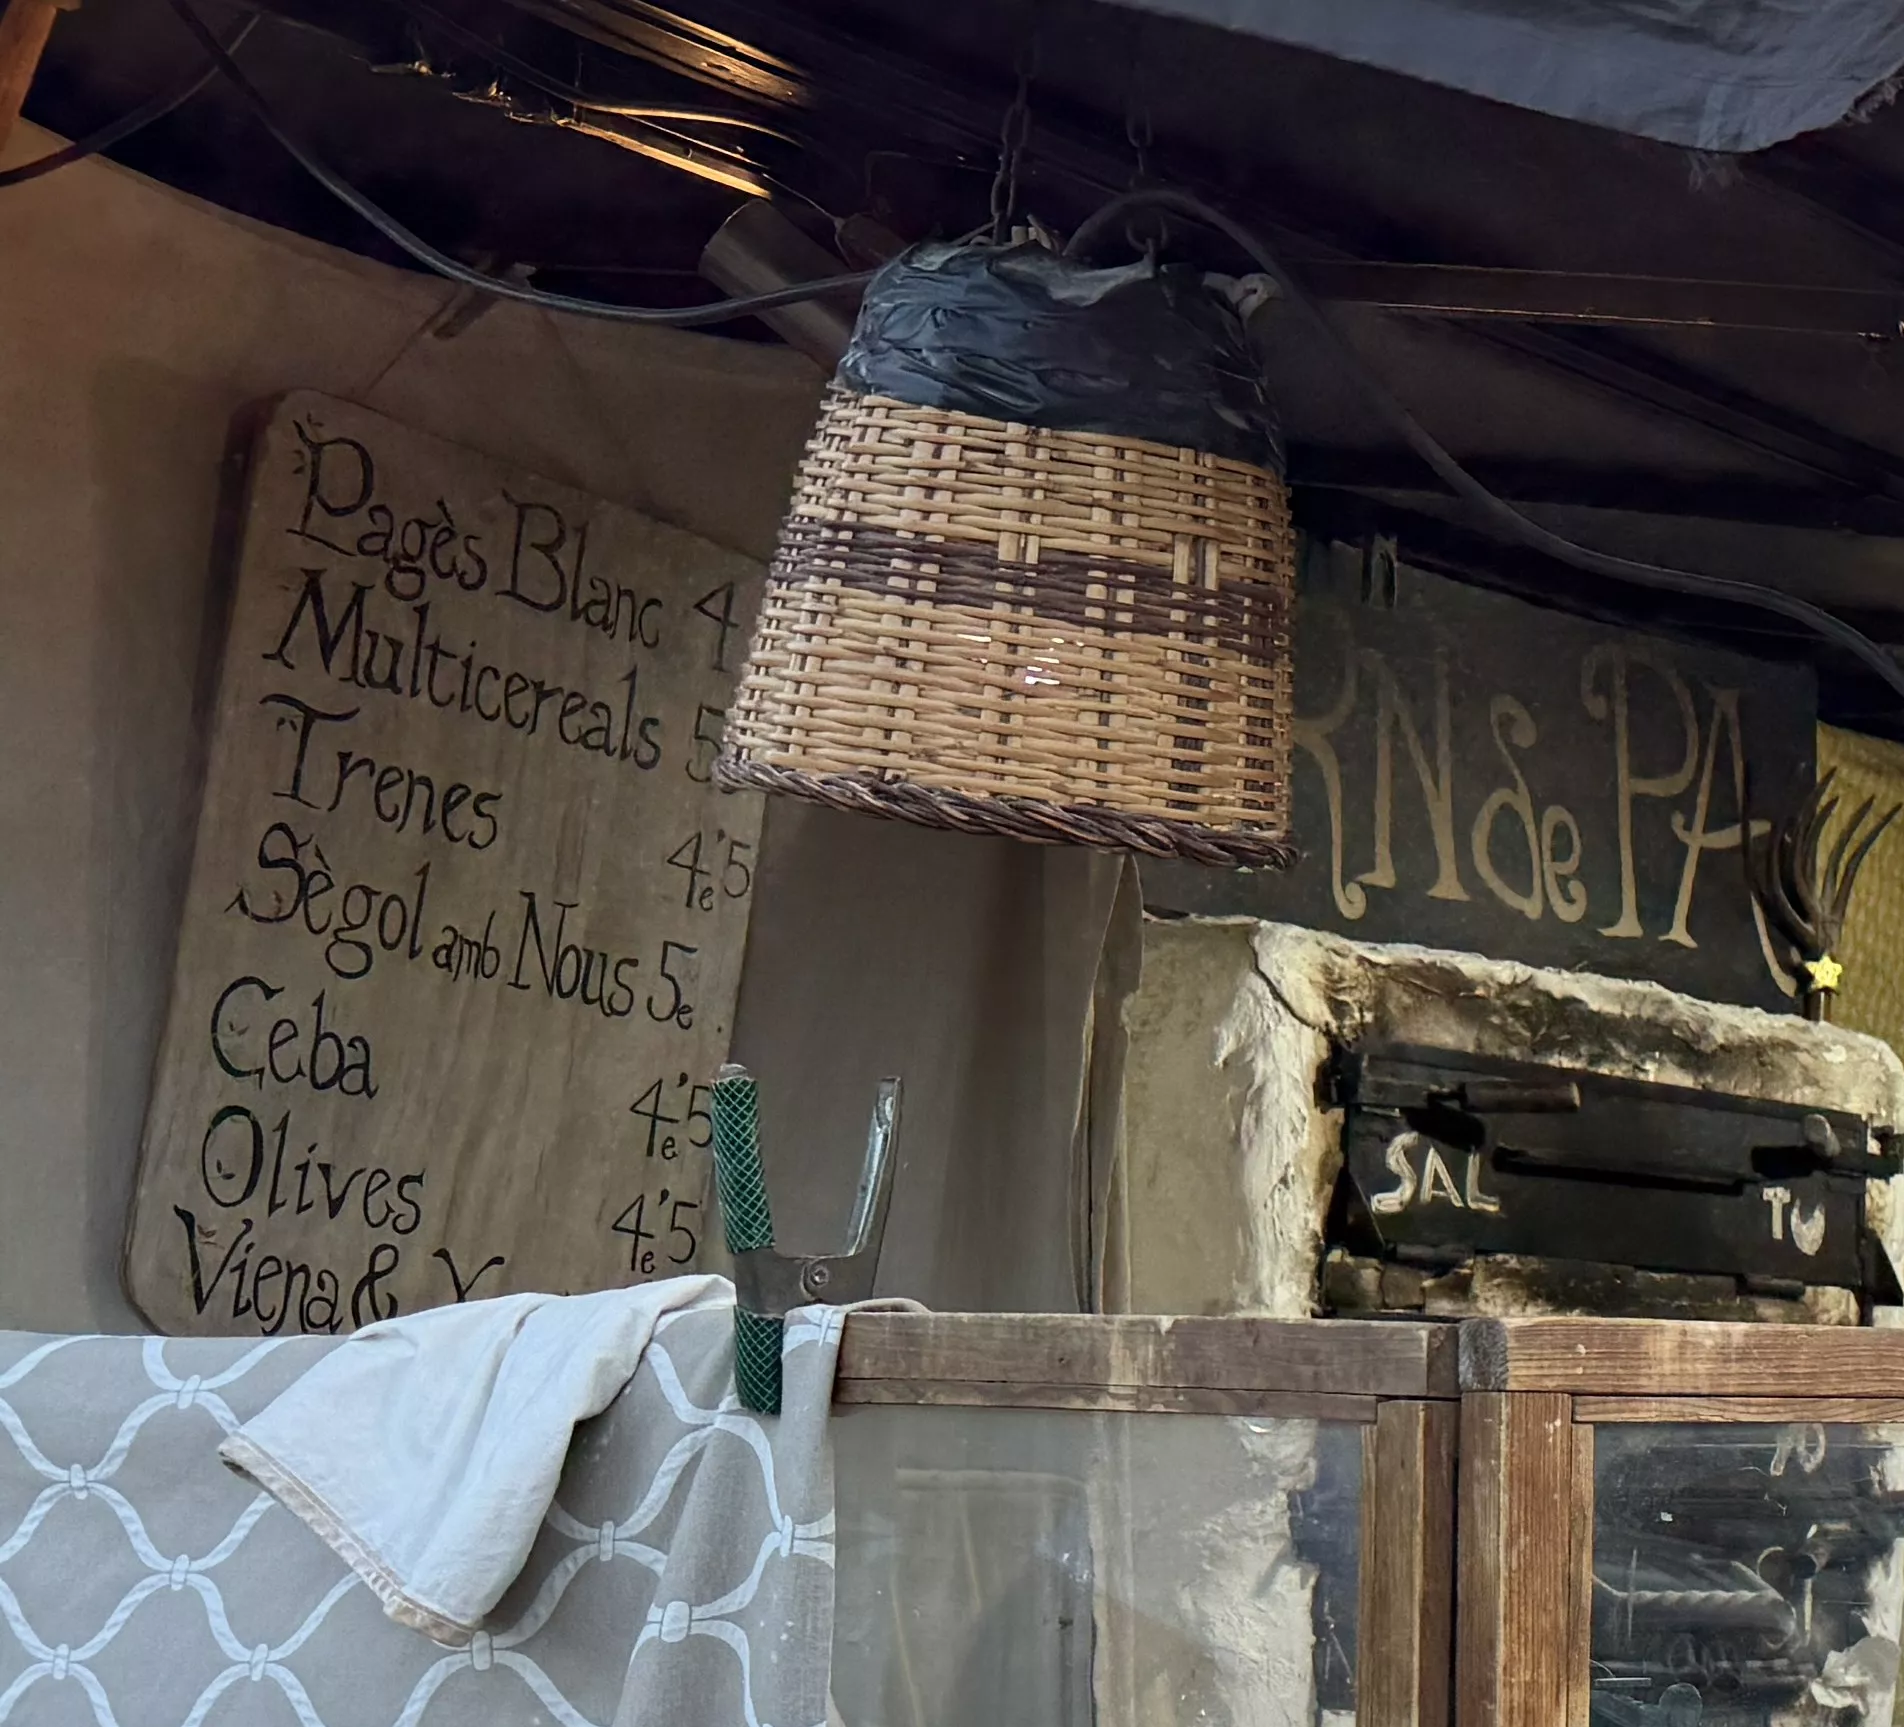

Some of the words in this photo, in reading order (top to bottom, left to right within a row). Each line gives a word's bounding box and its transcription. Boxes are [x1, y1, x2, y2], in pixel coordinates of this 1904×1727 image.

[286, 420, 488, 601] Pagès
[496, 488, 663, 650] Blanc
[262, 568, 662, 770] Multicereals
[260, 693, 504, 850] Trenes
[1294, 605, 1470, 920] RN
[1472, 693, 1587, 923] de
[1581, 640, 1798, 998] PA
[432, 911, 500, 982] amb
[508, 890, 639, 1018] Nous
[211, 976, 379, 1100] Ceba
[202, 1106, 425, 1235] Olives
[1370, 1130, 1502, 1215] SAL
[175, 1205, 344, 1336] Viena
